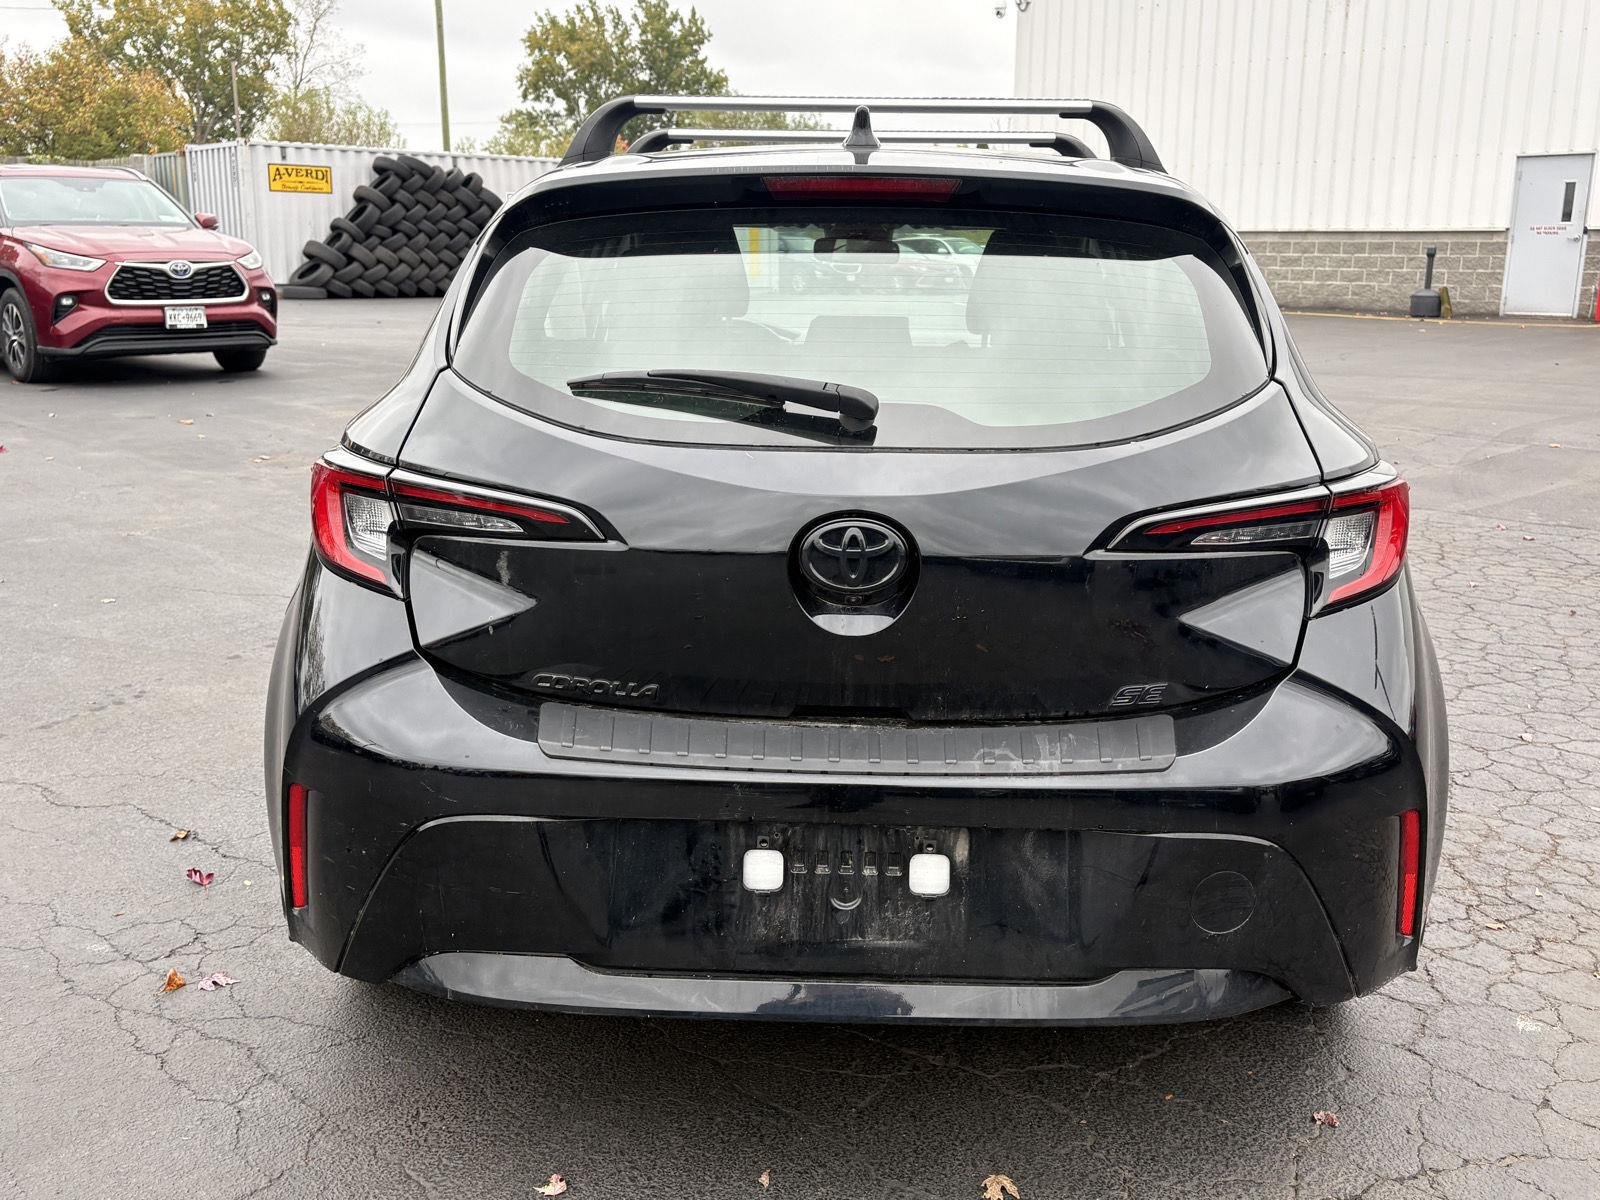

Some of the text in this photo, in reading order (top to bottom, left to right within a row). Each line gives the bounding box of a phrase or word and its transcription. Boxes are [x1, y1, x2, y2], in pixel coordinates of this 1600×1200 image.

[272, 167, 329, 184] A-VERDI
[532, 673, 659, 700] COROLLA
[1110, 682, 1168, 706] SE
